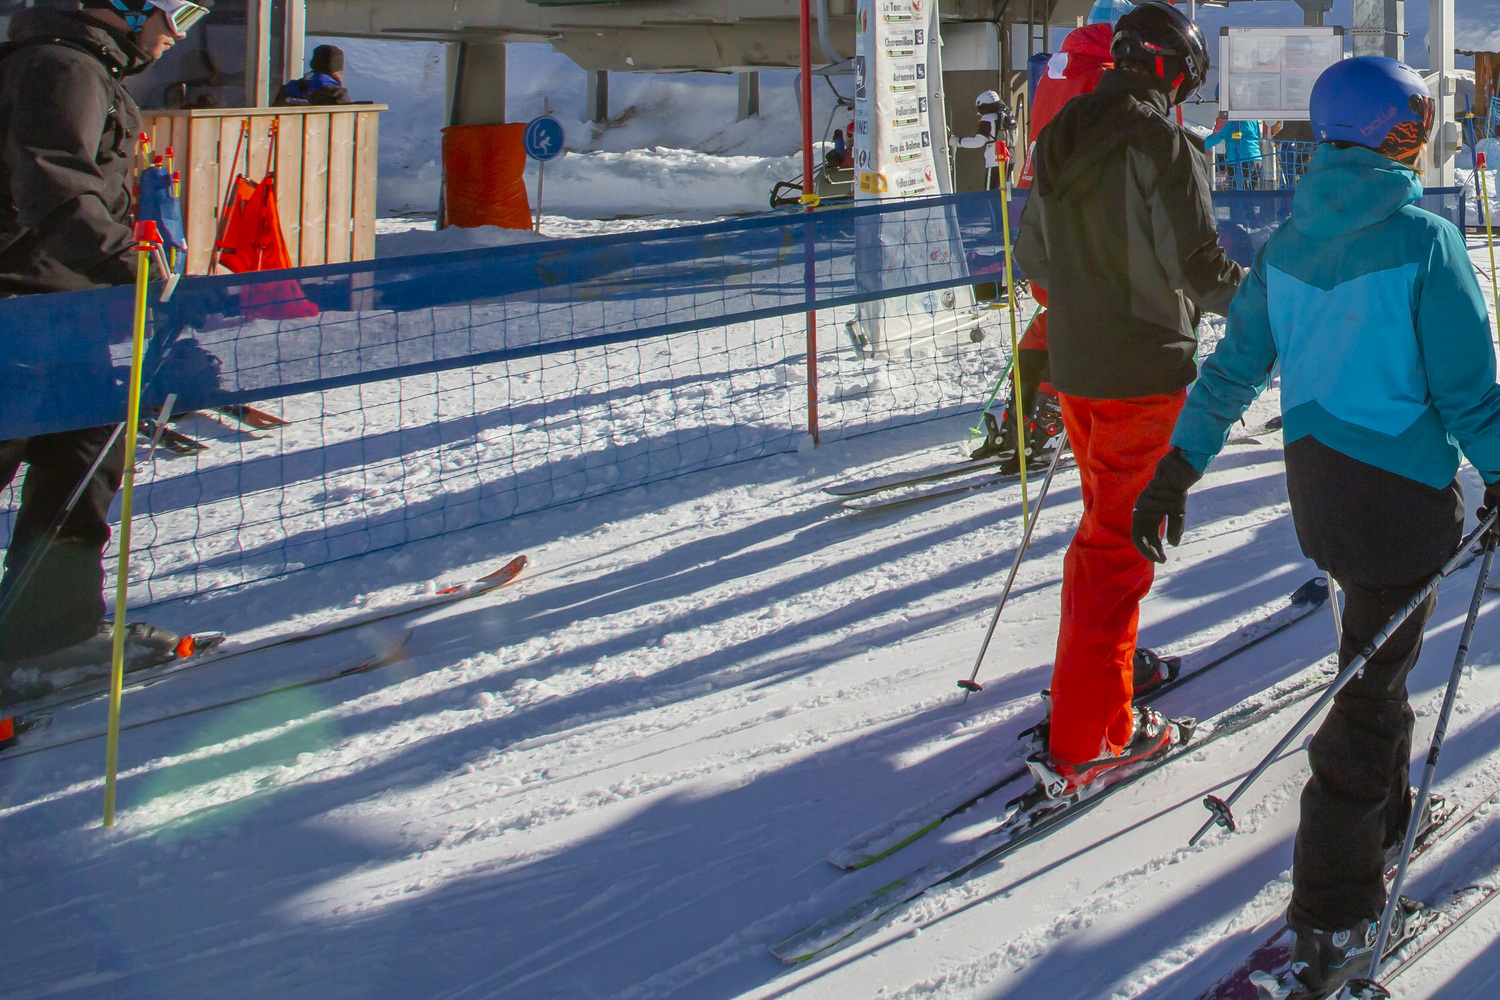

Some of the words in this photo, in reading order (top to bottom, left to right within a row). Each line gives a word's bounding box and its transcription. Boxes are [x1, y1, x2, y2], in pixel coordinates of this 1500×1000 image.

[890, 1, 902, 12] Tour
[885, 36, 914, 47] Charamillon
[1185, 54, 1199, 80] DLX
[895, 105, 918, 117] Vallorcine
[899, 141, 905, 152] de
[905, 139, 921, 151] Balme
